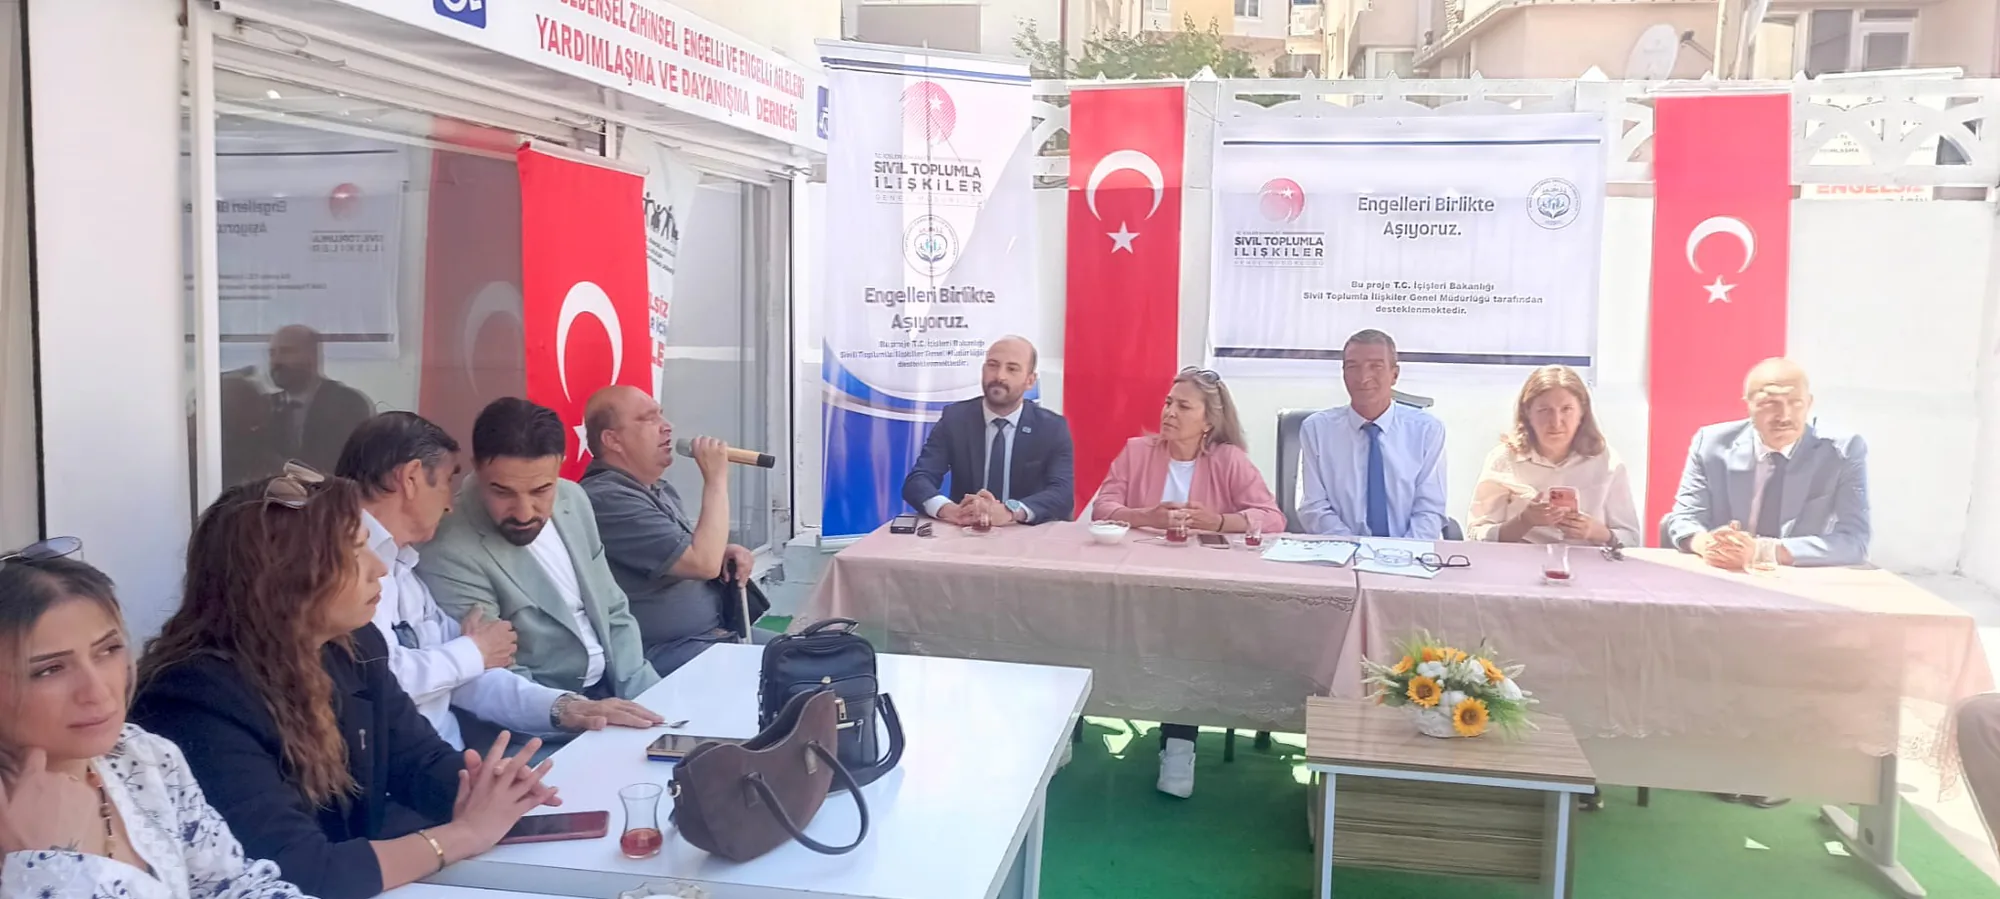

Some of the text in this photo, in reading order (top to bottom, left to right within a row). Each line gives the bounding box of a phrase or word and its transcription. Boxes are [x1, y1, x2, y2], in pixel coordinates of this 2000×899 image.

[629, 2, 679, 51] ZİHİNSEL
[683, 27, 724, 68] ENGELLİ
[725, 43, 738, 73] VE
[739, 49, 773, 88] ENGELLİ
[773, 64, 805, 100] AİLELERİ
[536, 13, 798, 132] YARDIMLAŞMA VE DAYANIŞMA DERNEĞİ
[874, 161, 982, 179] SİVİL TOPLUMLA
[874, 175, 982, 193] İLİŞKİLER
[1357, 196, 1495, 215] Engelleri Birlikte
[1383, 221, 1462, 239] Aşıyoruz.
[1234, 236, 1324, 246] SİVİL TOPLUMLA
[1234, 247, 1324, 258] İLİŞKİLER
[1351, 280, 1495, 292] Bu proje T.C. İçişleri Bakanlığı
[864, 286, 996, 307] Engelleri Birlikte
[1303, 292, 1544, 304] Sivil Toplumla İlişkiler Genel Müdürlüğü tarafından
[1375, 305, 1468, 315] desteklenmektedir.
[891, 313, 969, 333] Aşıyoruz.
